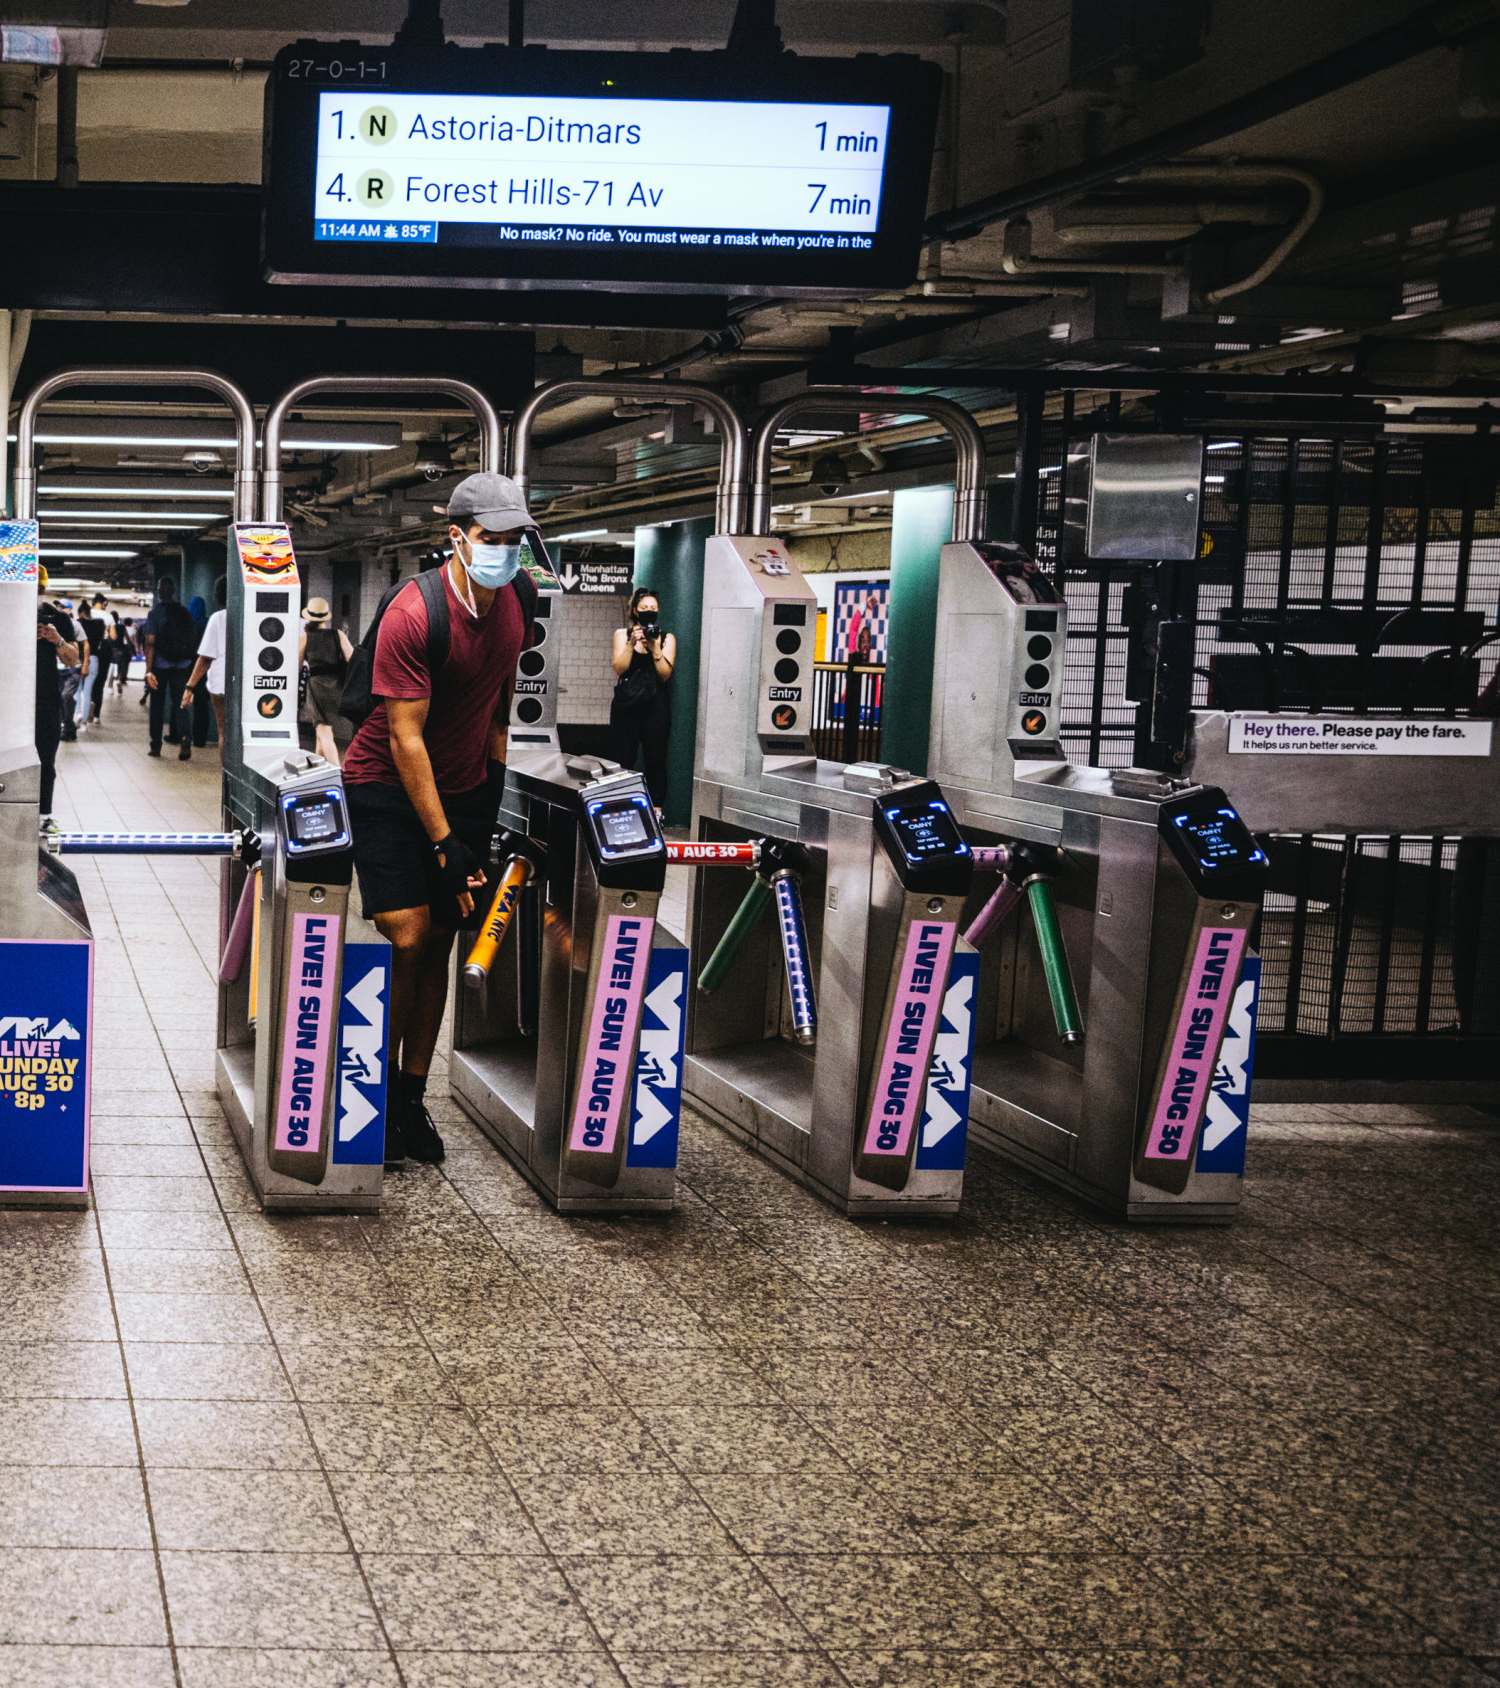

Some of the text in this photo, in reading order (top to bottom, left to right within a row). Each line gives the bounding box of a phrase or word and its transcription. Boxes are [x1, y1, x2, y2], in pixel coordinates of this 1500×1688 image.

[289, 60, 386, 79] 27-0-1-1
[331, 110, 878, 152] 1. N Astoria-Ditmars 1 min
[325, 173, 871, 215] 4. R Forest Hills-71 Av 7 min
[320, 224, 356, 237] 11:44
[358, 224, 381, 237] AM
[500, 227, 872, 249] No mask? No ride. You must wear a mask when you're in the
[580, 564, 629, 574] Manhattan
[581, 574, 598, 583] The
[601, 574, 628, 583] Bronx
[580, 583, 615, 593] Queens
[255, 676, 287, 690] Entry
[516, 681, 547, 694] Entry
[770, 688, 801, 702] Entry
[1021, 693, 1051, 707] Entry
[1244, 722, 1466, 740] Hey there. Please pay the fare.
[1243, 740, 1249, 749] It
[1251, 740, 1277, 751] helps
[1279, 742, 1290, 750] us
[1310, 741, 1339, 750] better
[1341, 741, 1377, 750] service.
[301, 809, 325, 818] OMNY
[608, 816, 632, 824] OMNY
[908, 821, 933, 830] OMNY
[1197, 828, 1222, 837] OMNY
[683, 846, 716, 858] AUG
[717, 846, 738, 857] 30
[487, 919, 505, 942] NYC
[288, 919, 326, 1146] LIVE! SUN AUG 30
[583, 920, 640, 1147] LIVE! SUN AUG 30
[877, 926, 943, 1150] LIVE! SUN AUG 30
[1, 1040, 60, 1057] LIVE!
[1158, 932, 1233, 1154] LIVE! SUN AUG 30
[45, 1075, 74, 1092] 30
[14, 1091, 45, 1111] 8p
